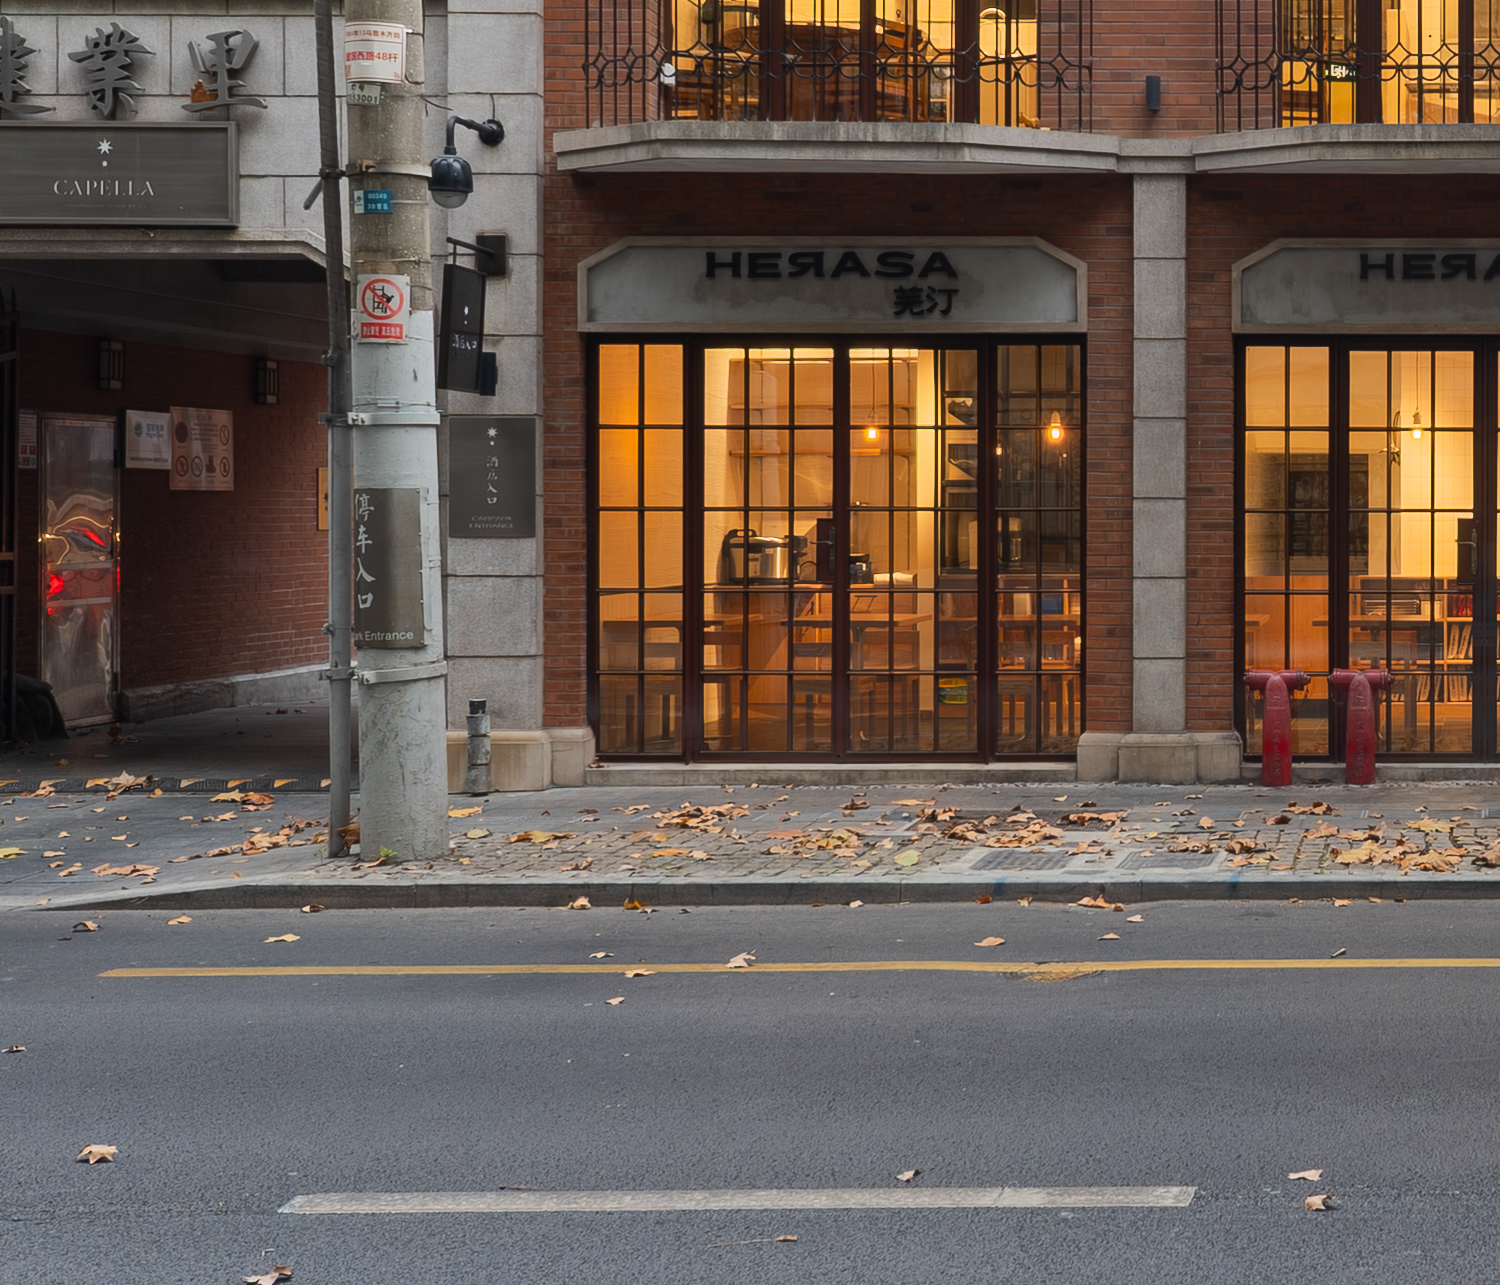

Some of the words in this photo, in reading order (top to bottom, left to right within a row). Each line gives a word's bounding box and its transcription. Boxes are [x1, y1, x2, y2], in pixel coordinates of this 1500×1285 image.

[53, 179, 155, 197] CAPELLA
[354, 493, 376, 609] 停车入口
[365, 630, 414, 642] Entrance
